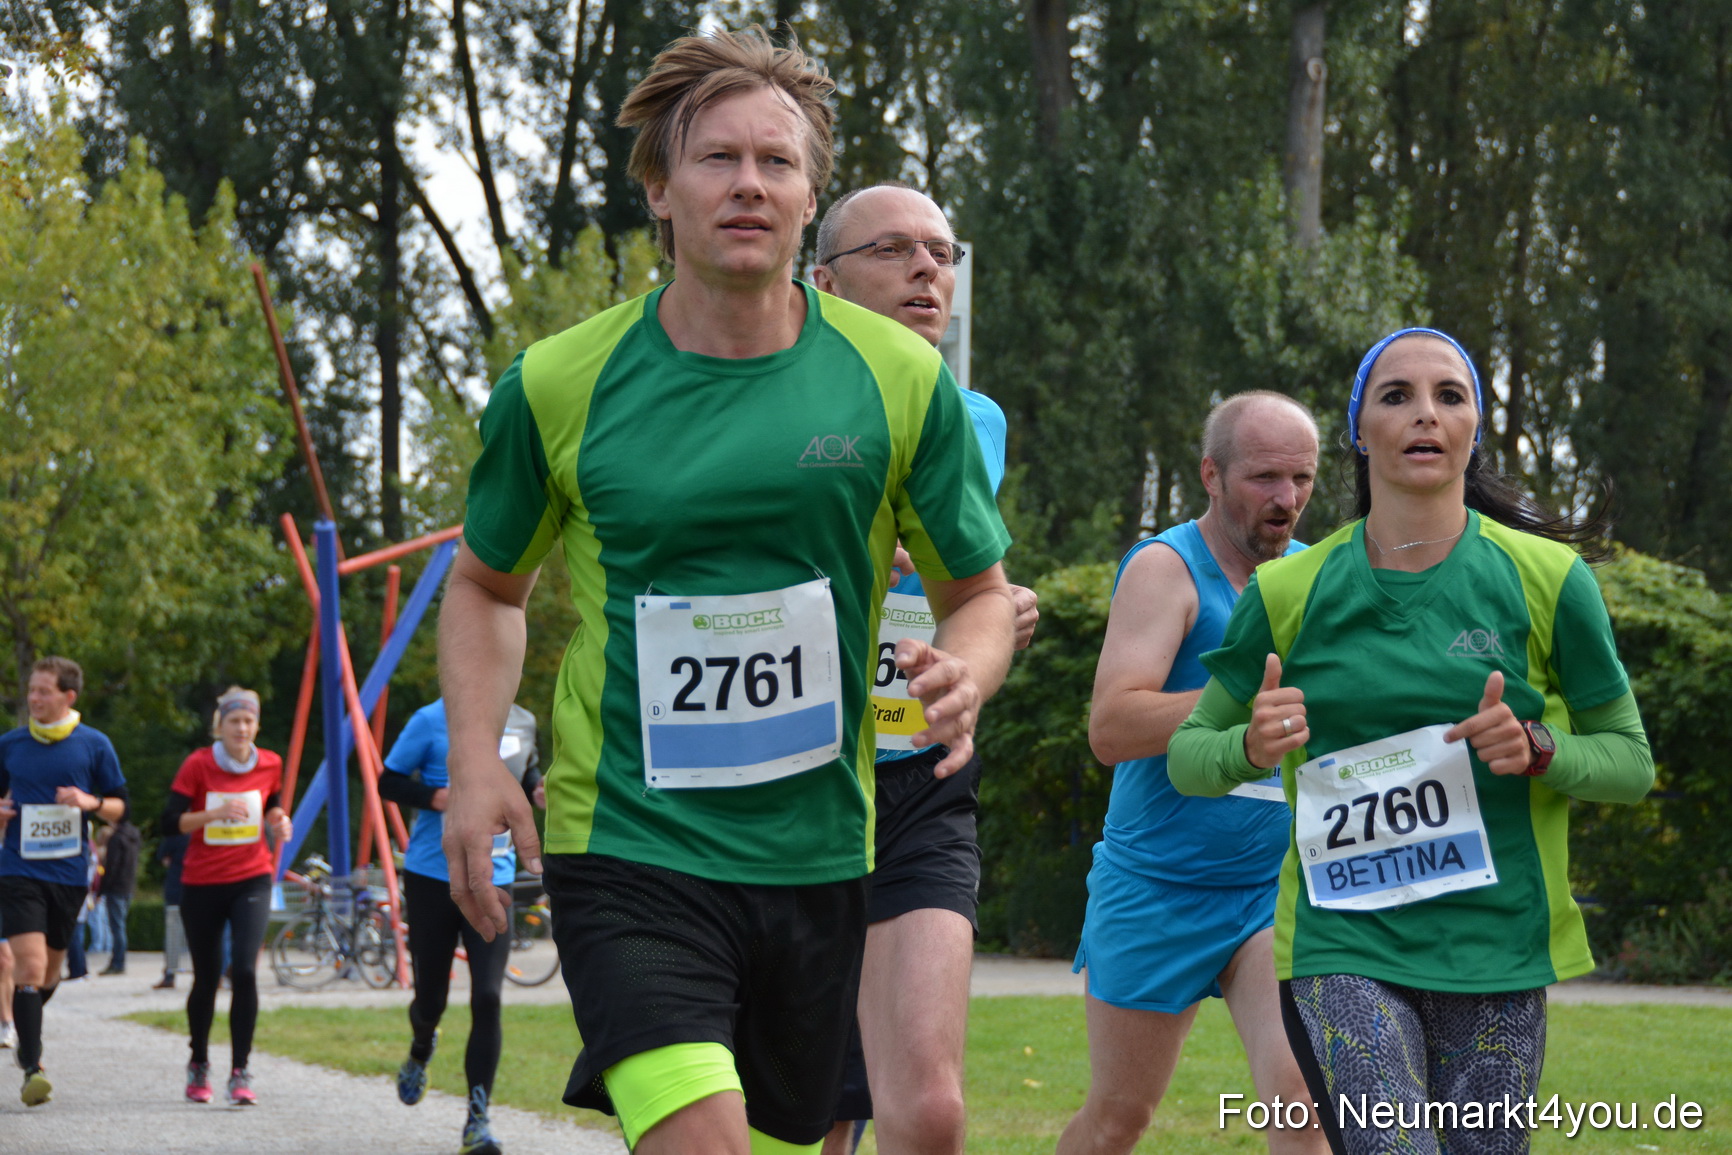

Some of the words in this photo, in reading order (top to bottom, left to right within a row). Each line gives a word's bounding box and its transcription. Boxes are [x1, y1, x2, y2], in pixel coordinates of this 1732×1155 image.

[799, 434, 863, 461] AOK
[712, 608, 783, 630] BOCK
[891, 609, 935, 625] BOCK
[1447, 629, 1504, 653] AOK
[671, 645, 803, 711] 2761
[653, 706, 660, 716] D
[1355, 749, 1415, 775] BOCK
[1323, 779, 1449, 849] 2760
[30, 820, 71, 838] 2558
[1310, 848, 1317, 858] D
